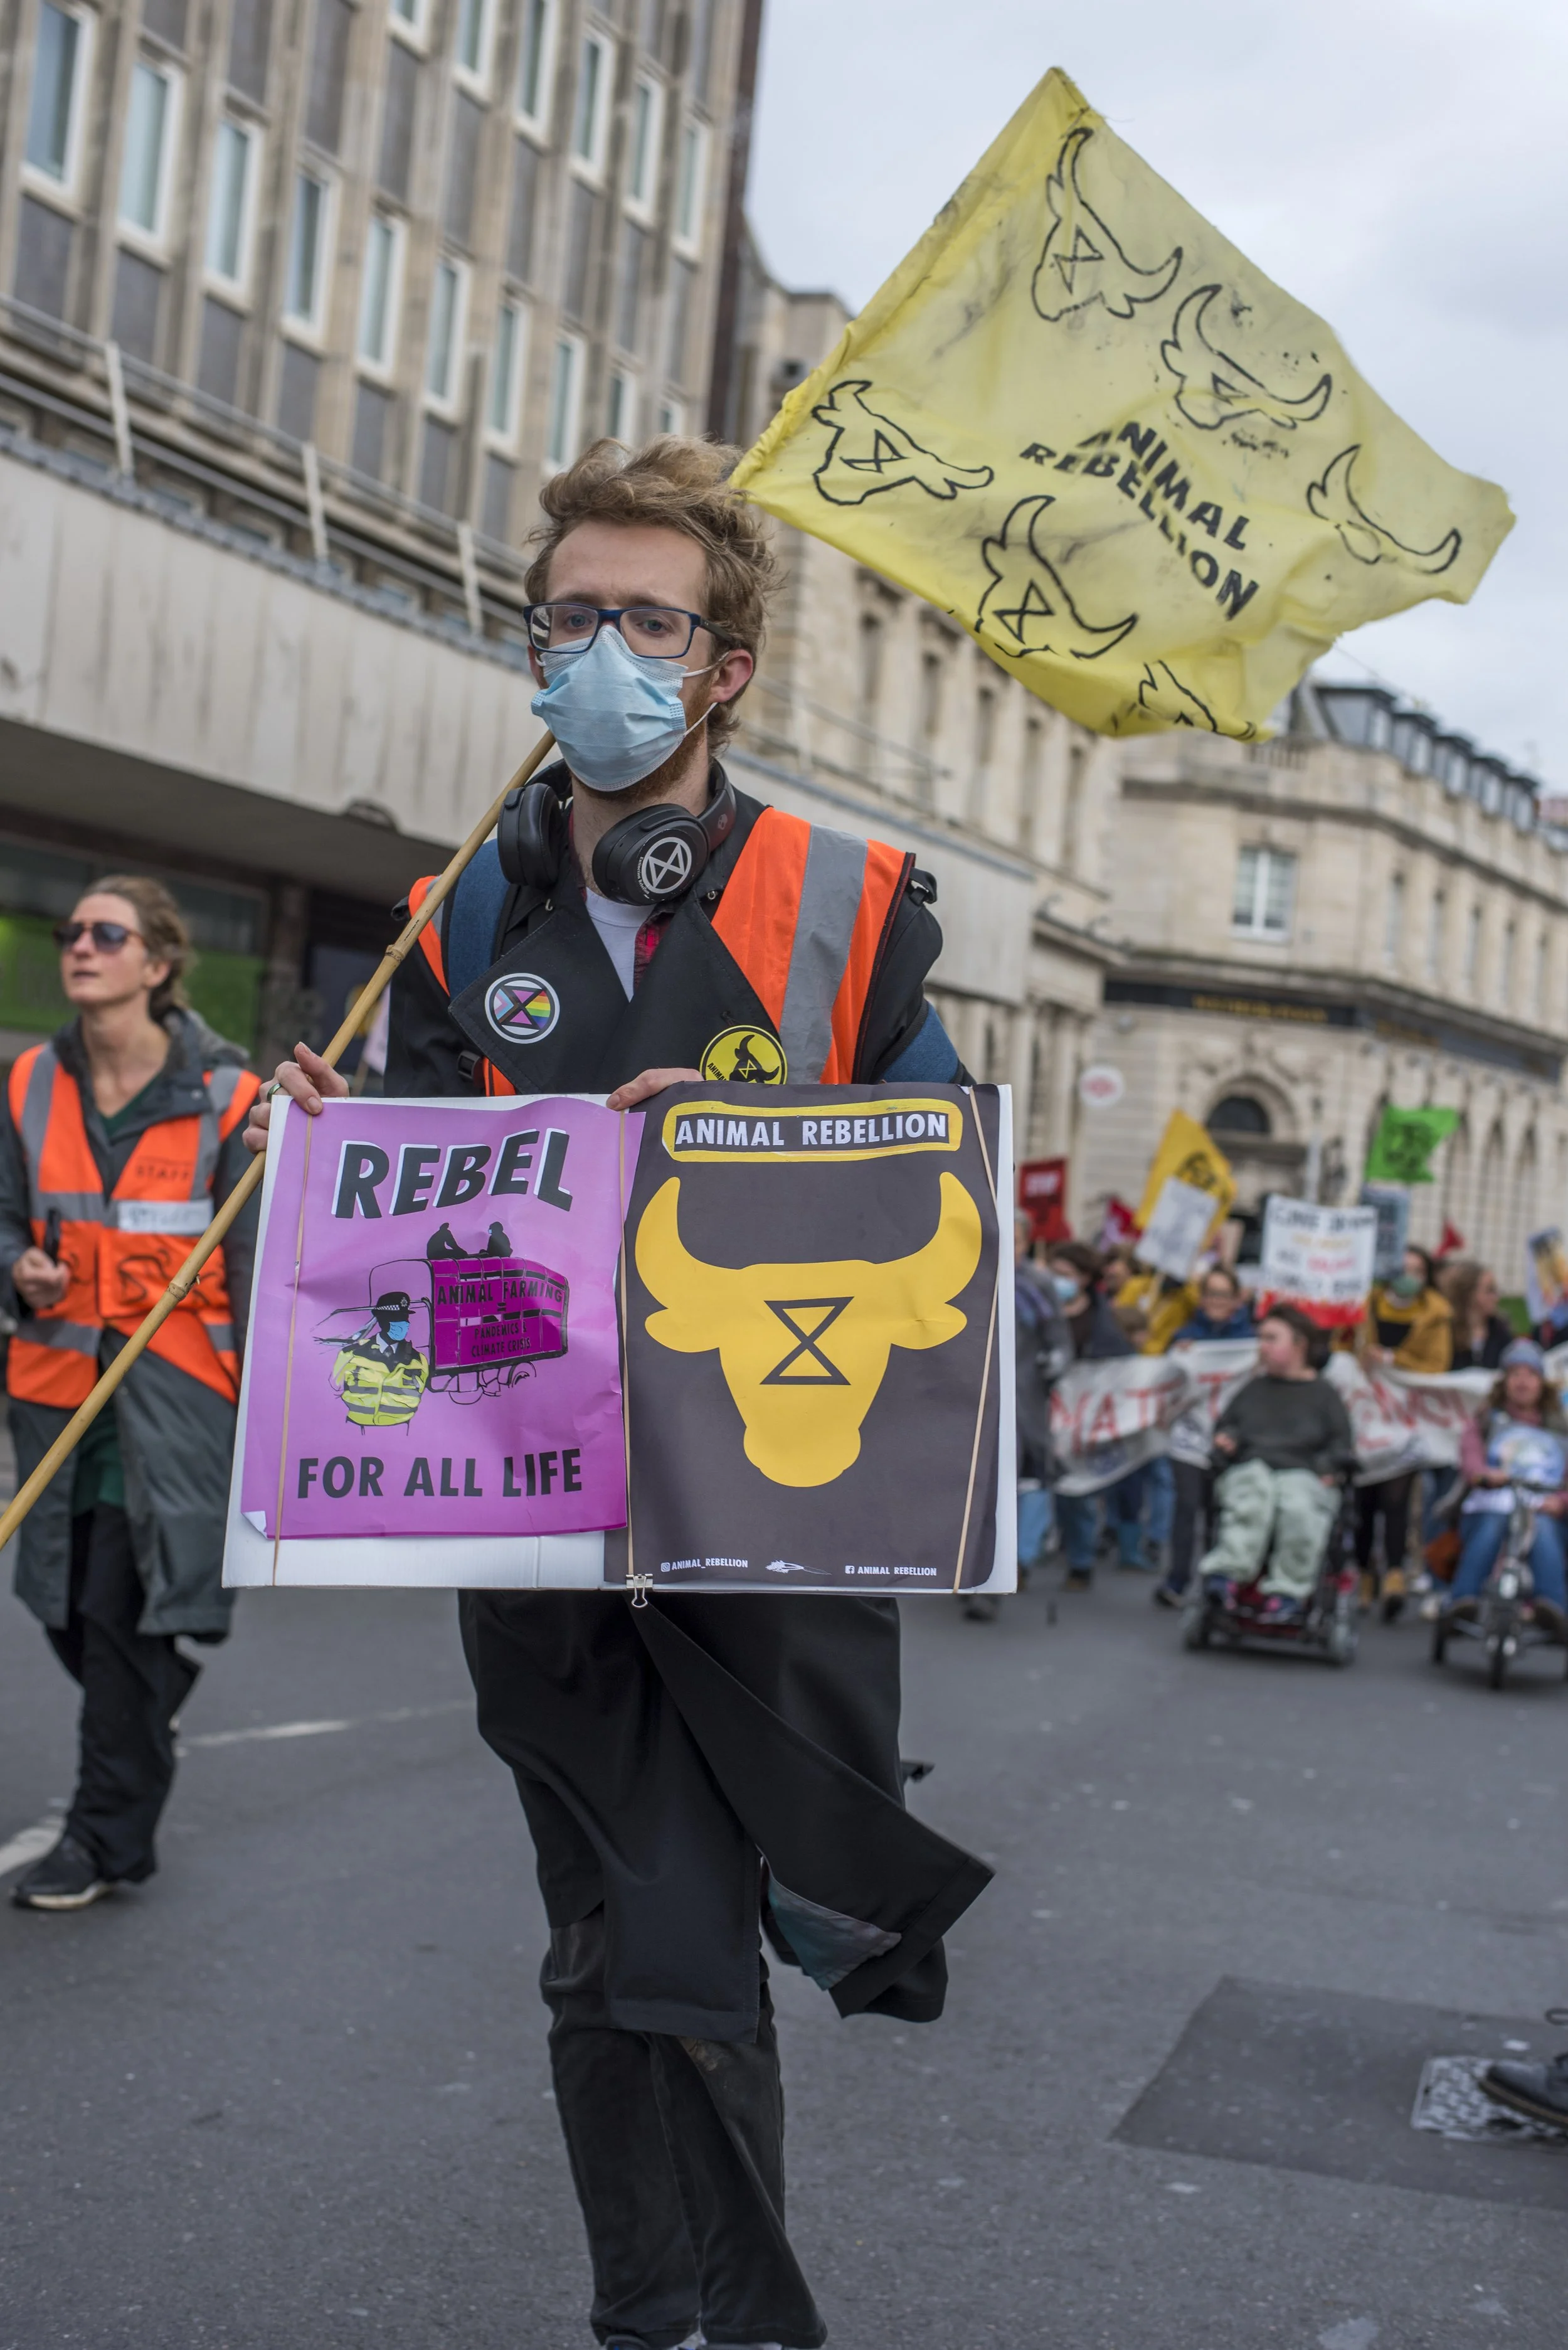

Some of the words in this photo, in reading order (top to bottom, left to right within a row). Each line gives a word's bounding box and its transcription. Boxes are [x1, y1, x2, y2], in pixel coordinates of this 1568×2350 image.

[1076, 422, 1249, 550] ANIMAL
[1019, 442, 1259, 621] REBELLION
[638, 880, 649, 894] Rebellion
[707, 1063, 726, 1080] ANIMA
[675, 1119, 785, 1146] ANIMAL
[802, 1114, 946, 1146] REBELLION
[331, 1128, 573, 1219] REBEL
[437, 1283, 494, 1305] ANIMAL
[503, 1280, 563, 1303] FARMING
[474, 1323, 519, 1339] PANDEMICS
[471, 1342, 504, 1358] CLIMATE
[507, 1337, 531, 1353] CRISIS
[298, 1456, 384, 1499] FOR
[403, 1457, 483, 1497] ALL
[502, 1448, 583, 1497] LIFE
[857, 1566, 891, 1575] ANIMAL
[894, 1566, 938, 1576] REBELLION
